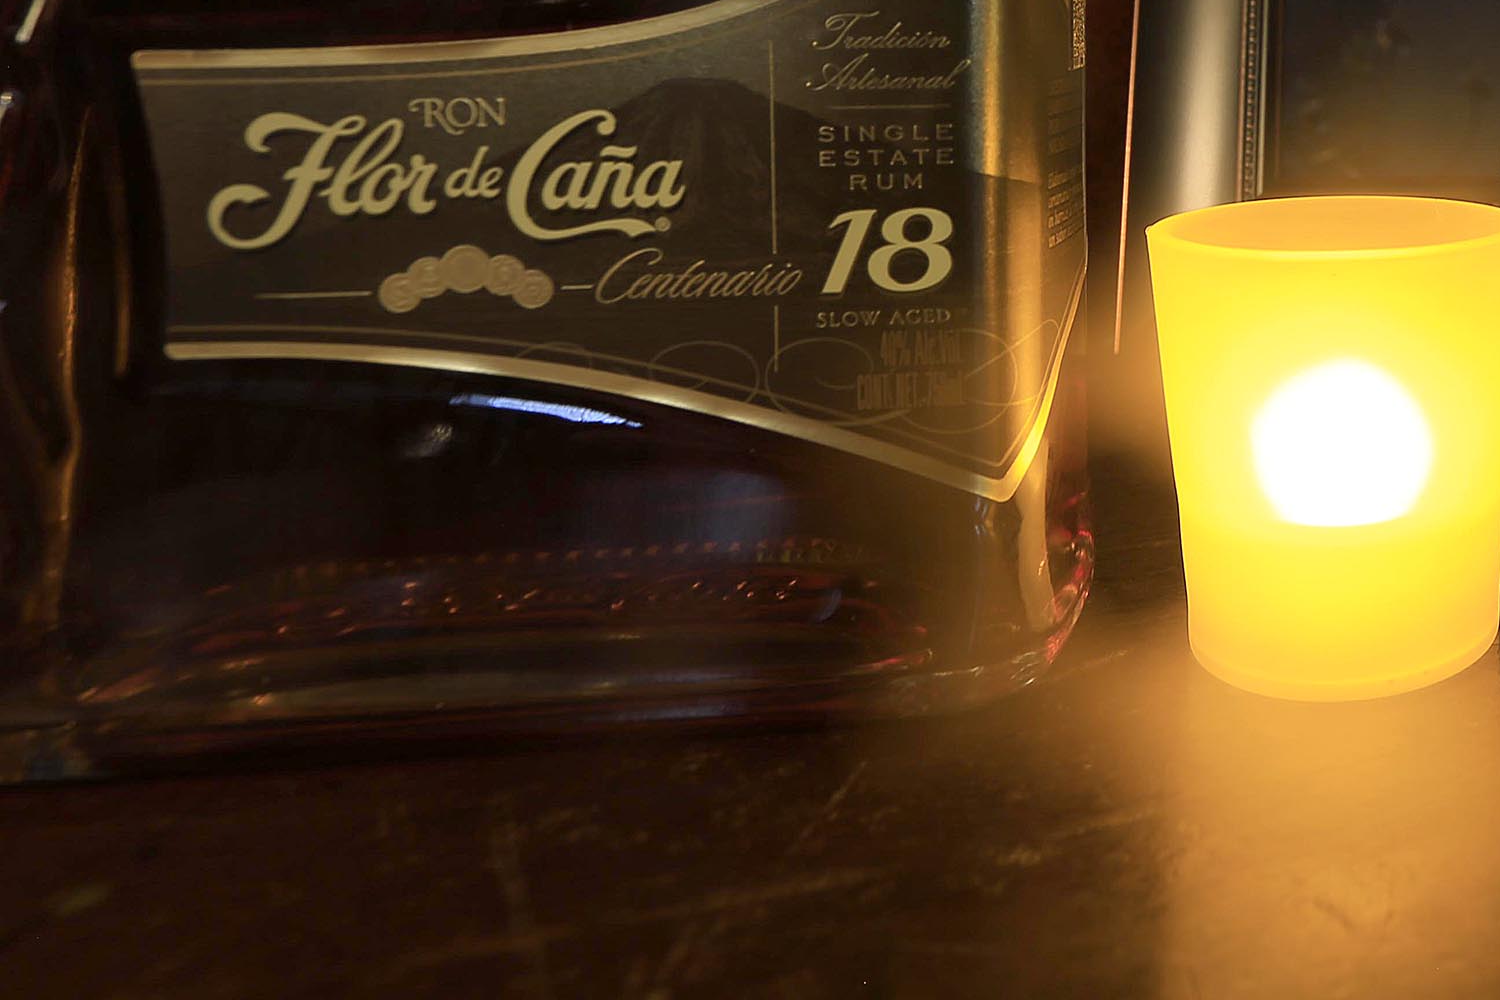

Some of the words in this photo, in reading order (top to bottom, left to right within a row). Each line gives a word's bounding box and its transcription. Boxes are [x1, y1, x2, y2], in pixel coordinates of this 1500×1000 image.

[812, 11, 950, 50] Tradición
[806, 53, 971, 91] Artesanal
[409, 97, 506, 134] RON
[818, 124, 953, 142] SINGLE
[819, 148, 954, 167] ESTATE
[208, 112, 437, 249] Flor
[445, 146, 500, 199] de
[506, 109, 685, 240] Caña
[849, 173, 923, 190] RUM
[820, 207, 954, 294] 18
[595, 248, 801, 304] Centenario
[816, 310, 880, 328] SLOW
[889, 308, 951, 325] AGED
